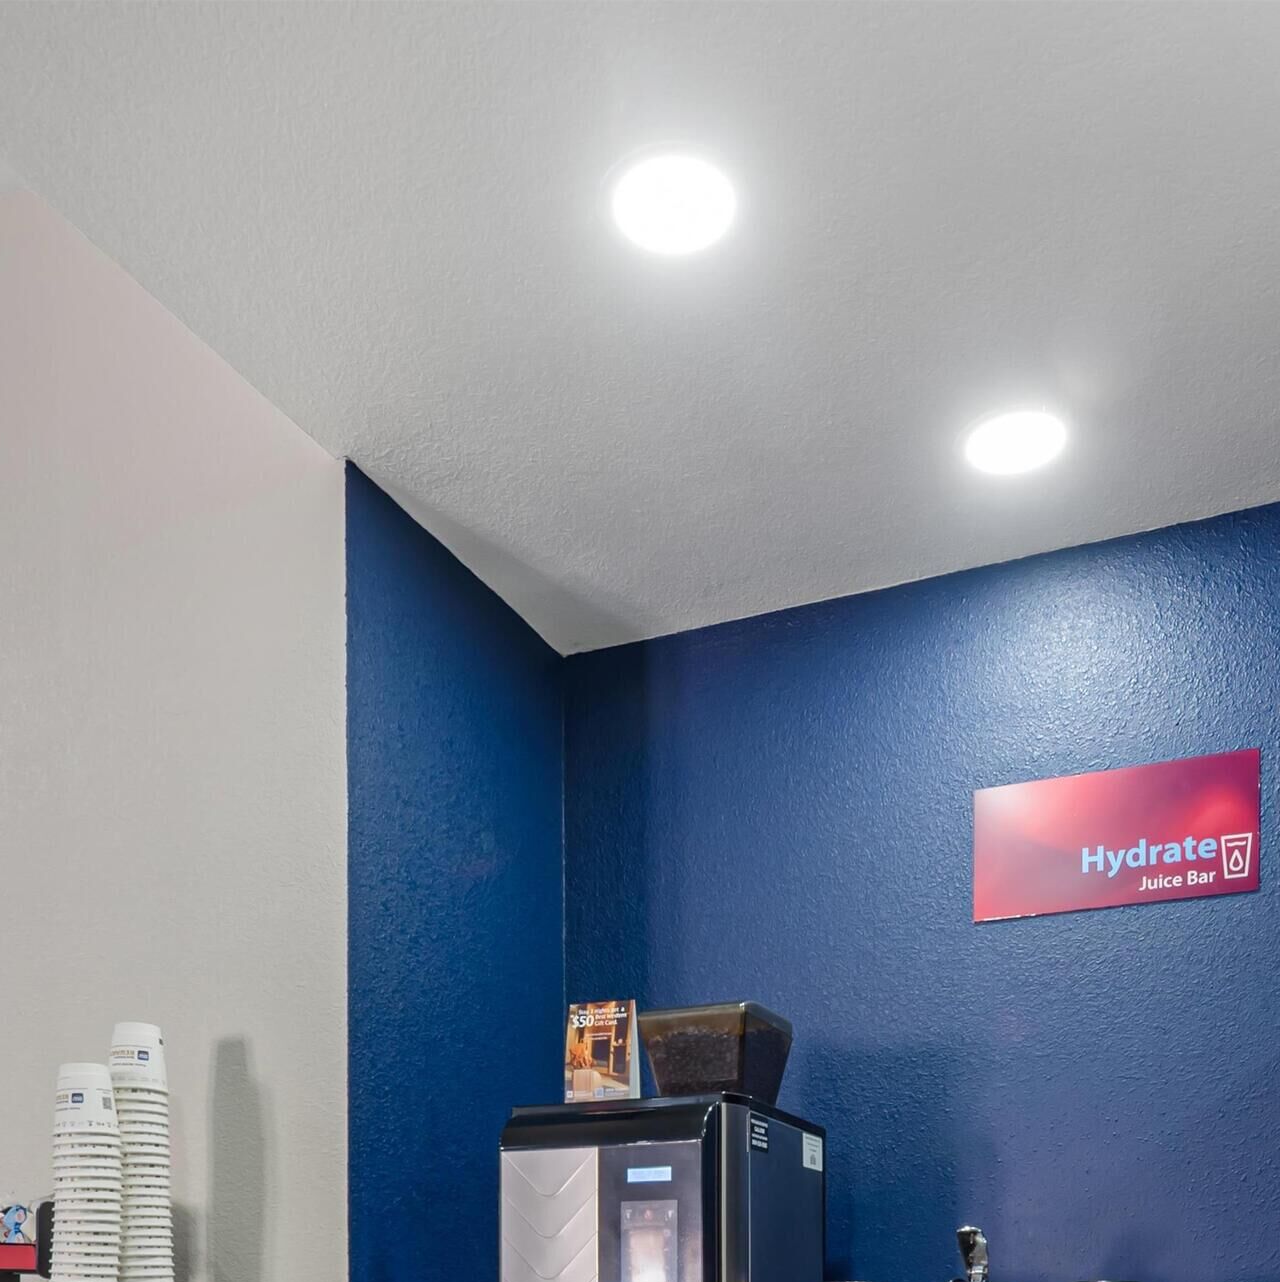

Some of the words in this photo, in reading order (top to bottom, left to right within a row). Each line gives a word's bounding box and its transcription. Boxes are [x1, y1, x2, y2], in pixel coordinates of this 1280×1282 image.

[1081, 836, 1217, 878] Hydrate
[1138, 874, 1182, 892] Juice
[1187, 870, 1216, 886] Bar
[572, 1015, 594, 1028] $50
